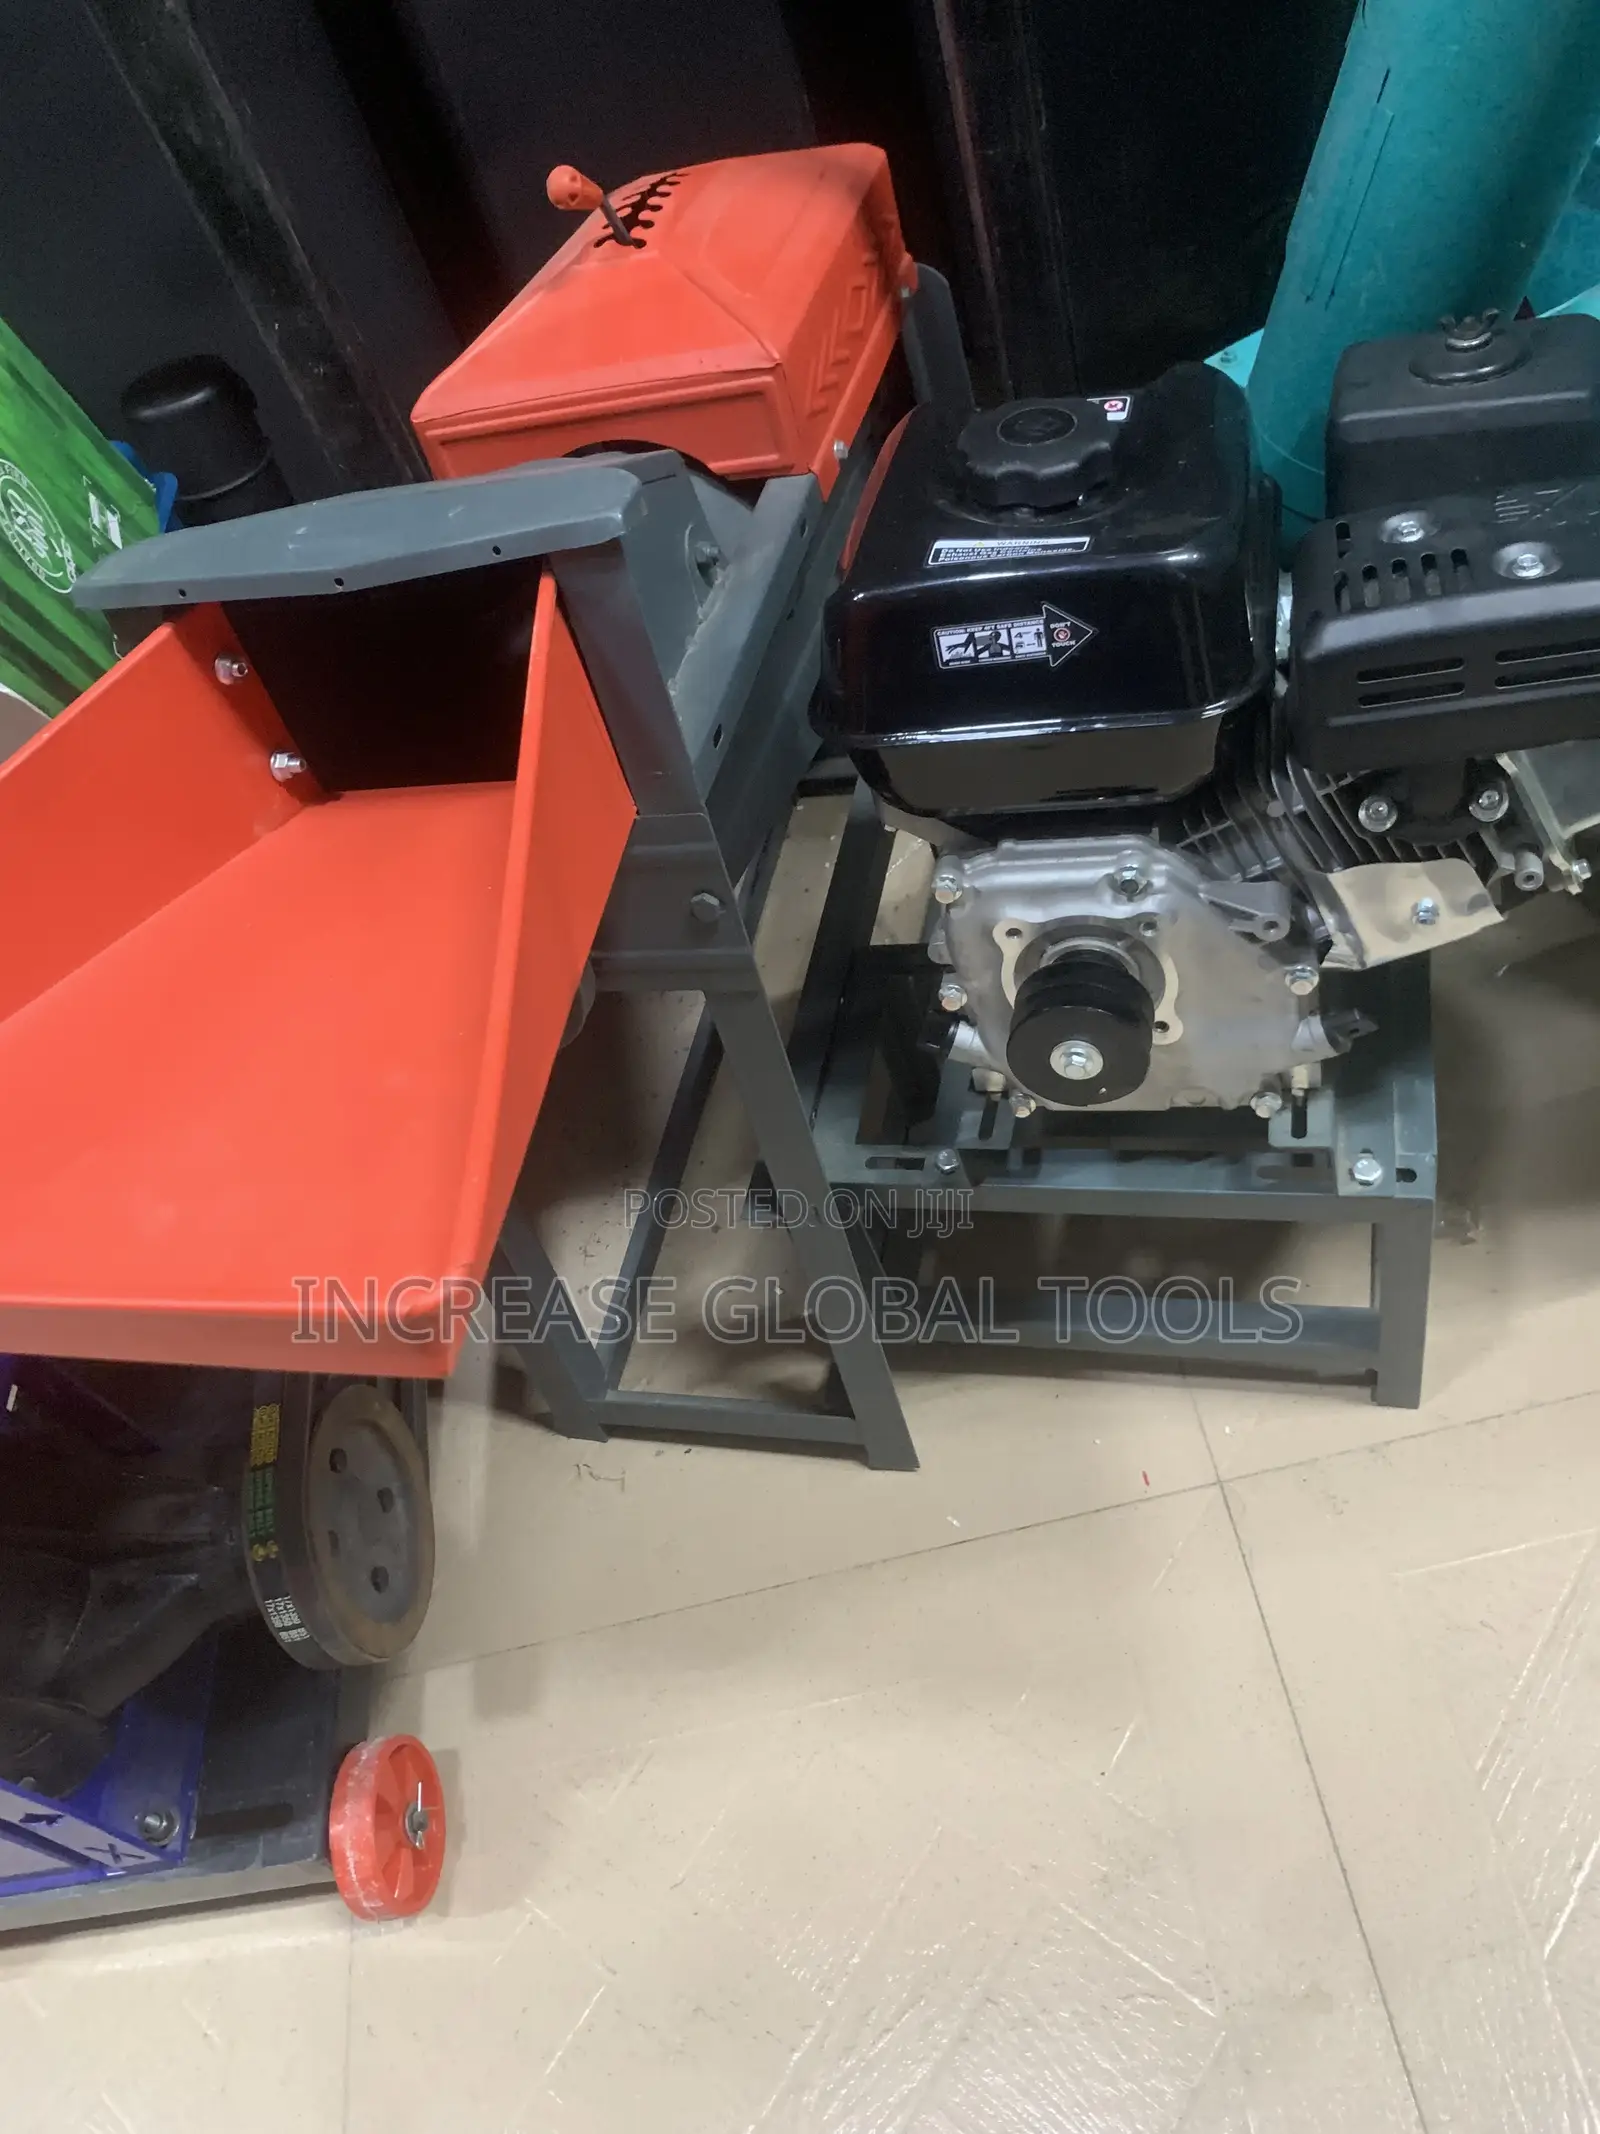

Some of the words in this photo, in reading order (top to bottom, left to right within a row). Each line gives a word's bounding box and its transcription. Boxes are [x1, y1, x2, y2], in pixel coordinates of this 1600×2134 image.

[996, 622, 1012, 630] SAFE
[1013, 619, 1045, 628] DISTANCE
[1051, 640, 1076, 648] TOUCH
